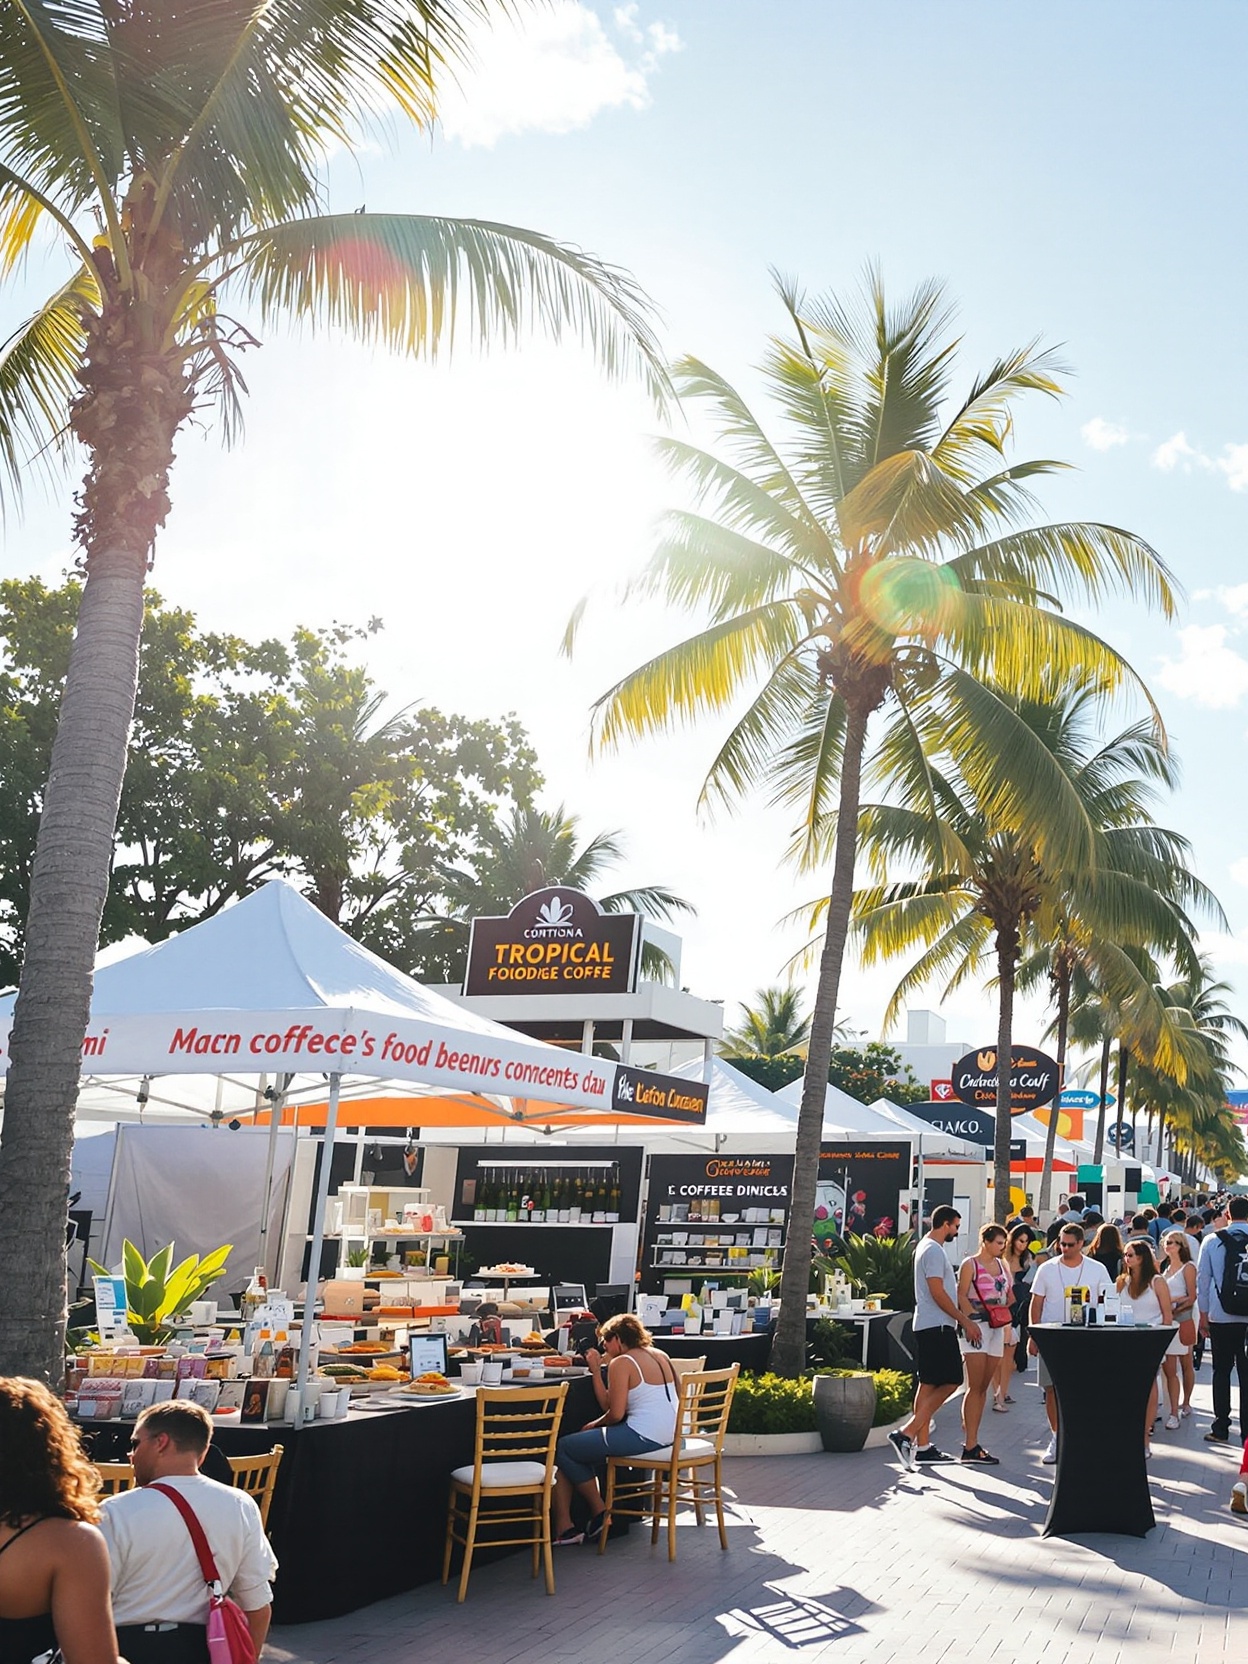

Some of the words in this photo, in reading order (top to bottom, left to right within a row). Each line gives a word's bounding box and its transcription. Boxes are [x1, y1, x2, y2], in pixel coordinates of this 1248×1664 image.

[495, 942, 615, 964] TROPICAL
[563, 966, 613, 980] COFFE
[381, 1032, 434, 1067] food
